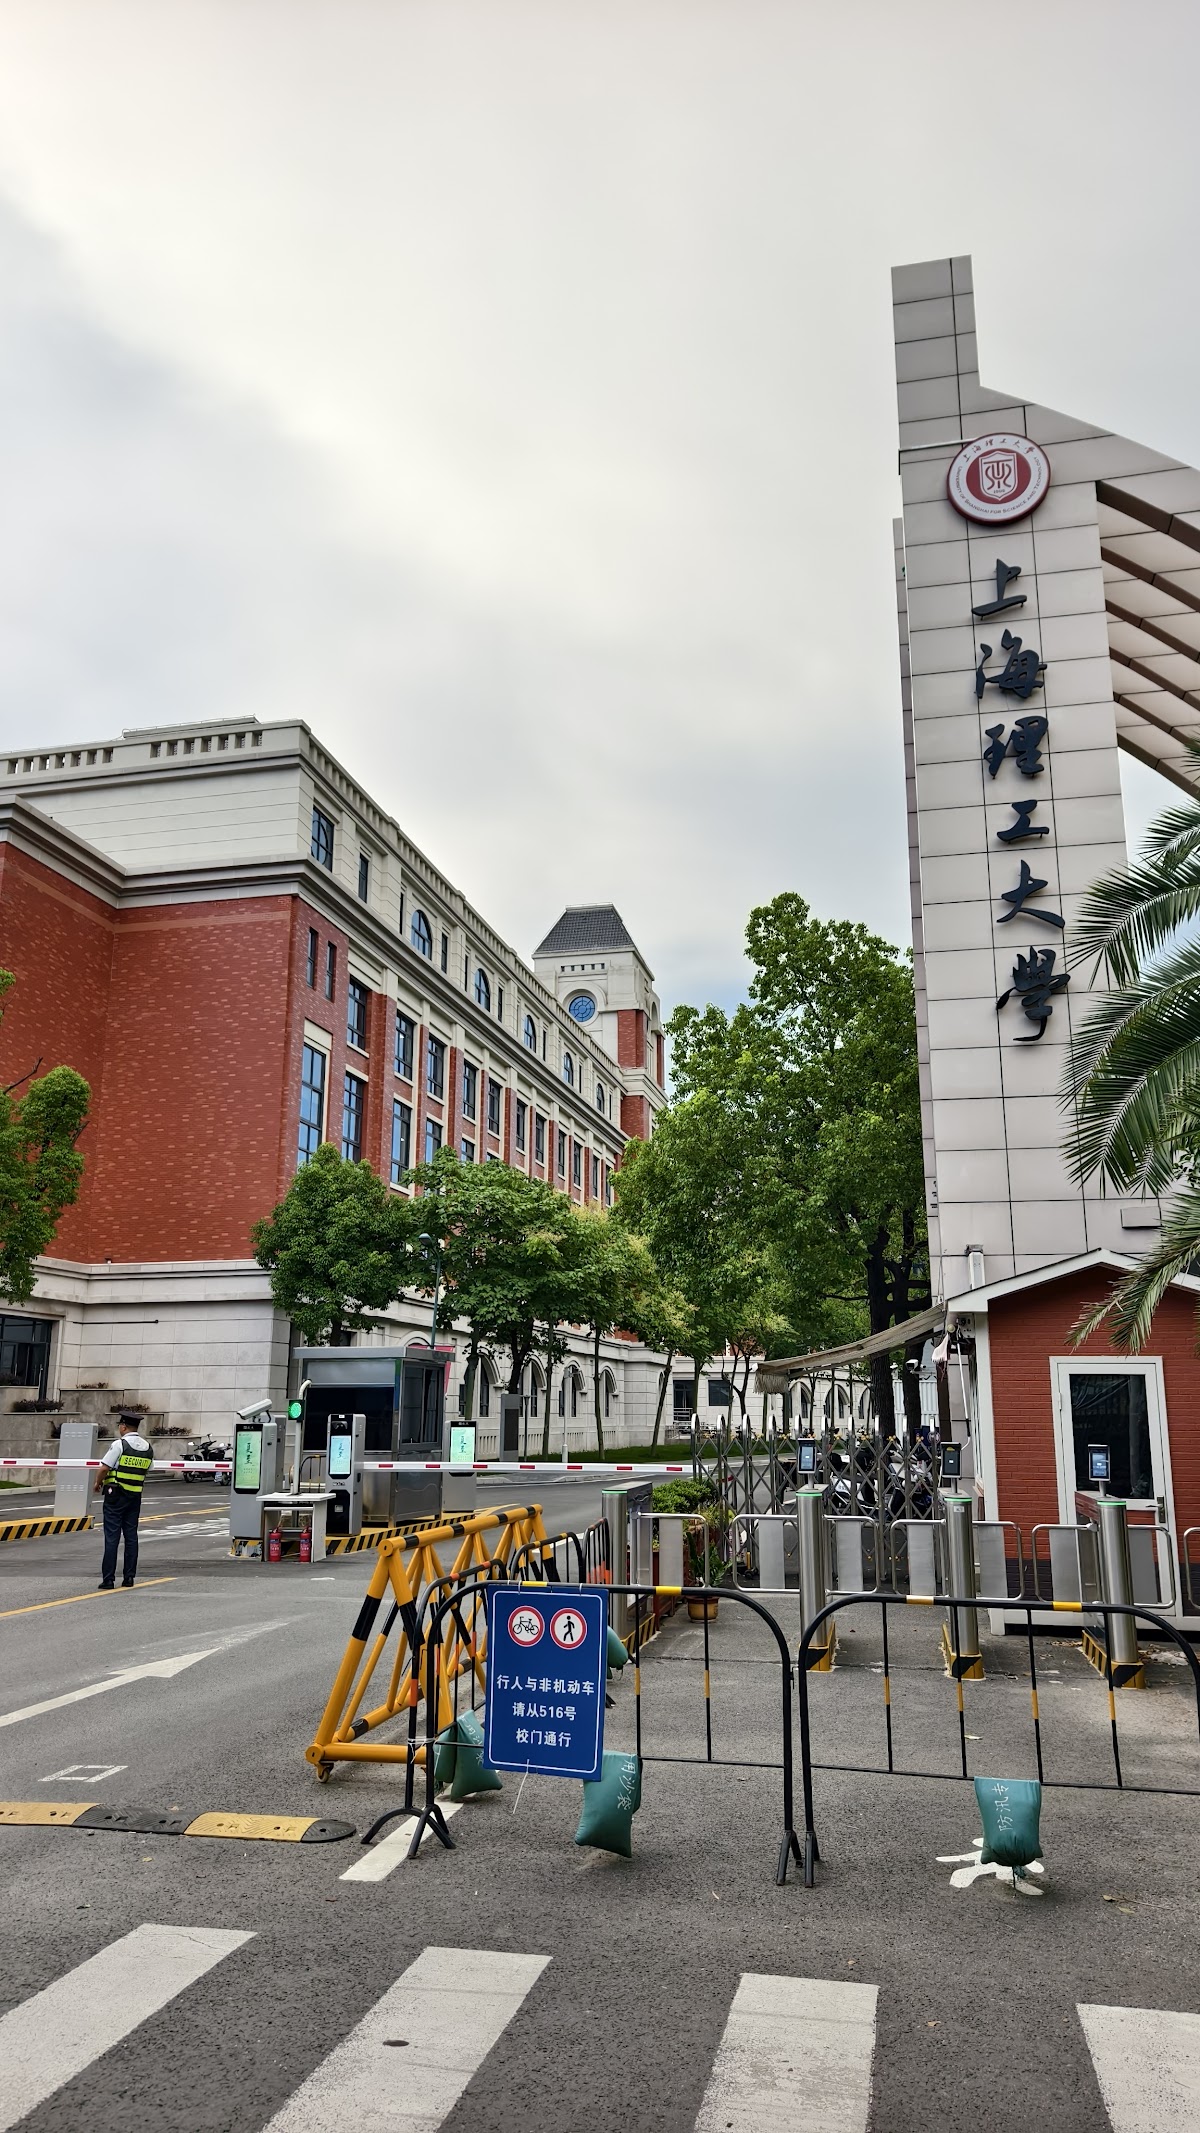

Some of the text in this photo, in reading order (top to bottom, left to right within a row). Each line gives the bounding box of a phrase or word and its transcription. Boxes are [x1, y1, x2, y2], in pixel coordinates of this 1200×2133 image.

[1002, 500, 1027, 514] SCIENCE
[496, 1674, 595, 1696] 行人与非机动车
[512, 1701, 577, 1721] 请从516号
[515, 1727, 572, 1748] 校门通行
[992, 1783, 1014, 1832] 防汛专
